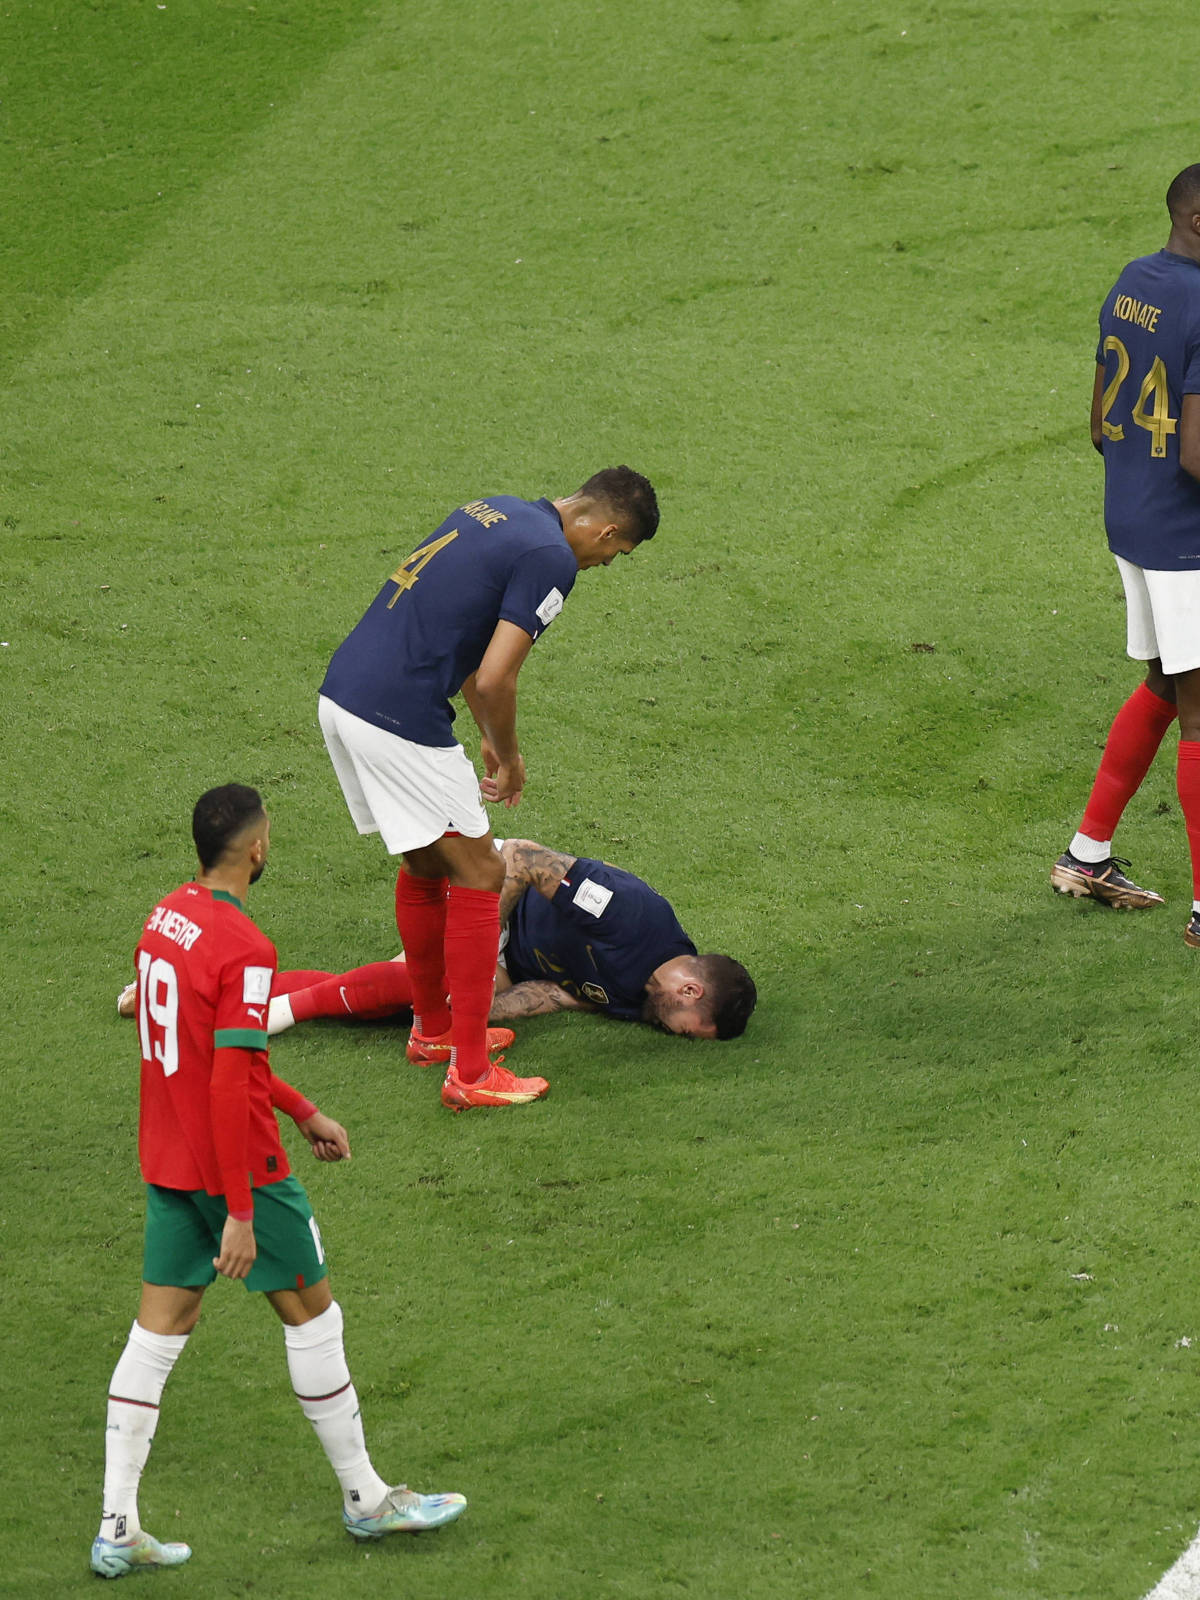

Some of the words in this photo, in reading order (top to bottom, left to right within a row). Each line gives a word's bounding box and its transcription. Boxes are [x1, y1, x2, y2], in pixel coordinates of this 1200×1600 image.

[1112, 293, 1162, 333] KONATE
[1101, 335, 1178, 458] 24
[386, 528, 459, 609] 4
[138, 949, 179, 1078] 19
